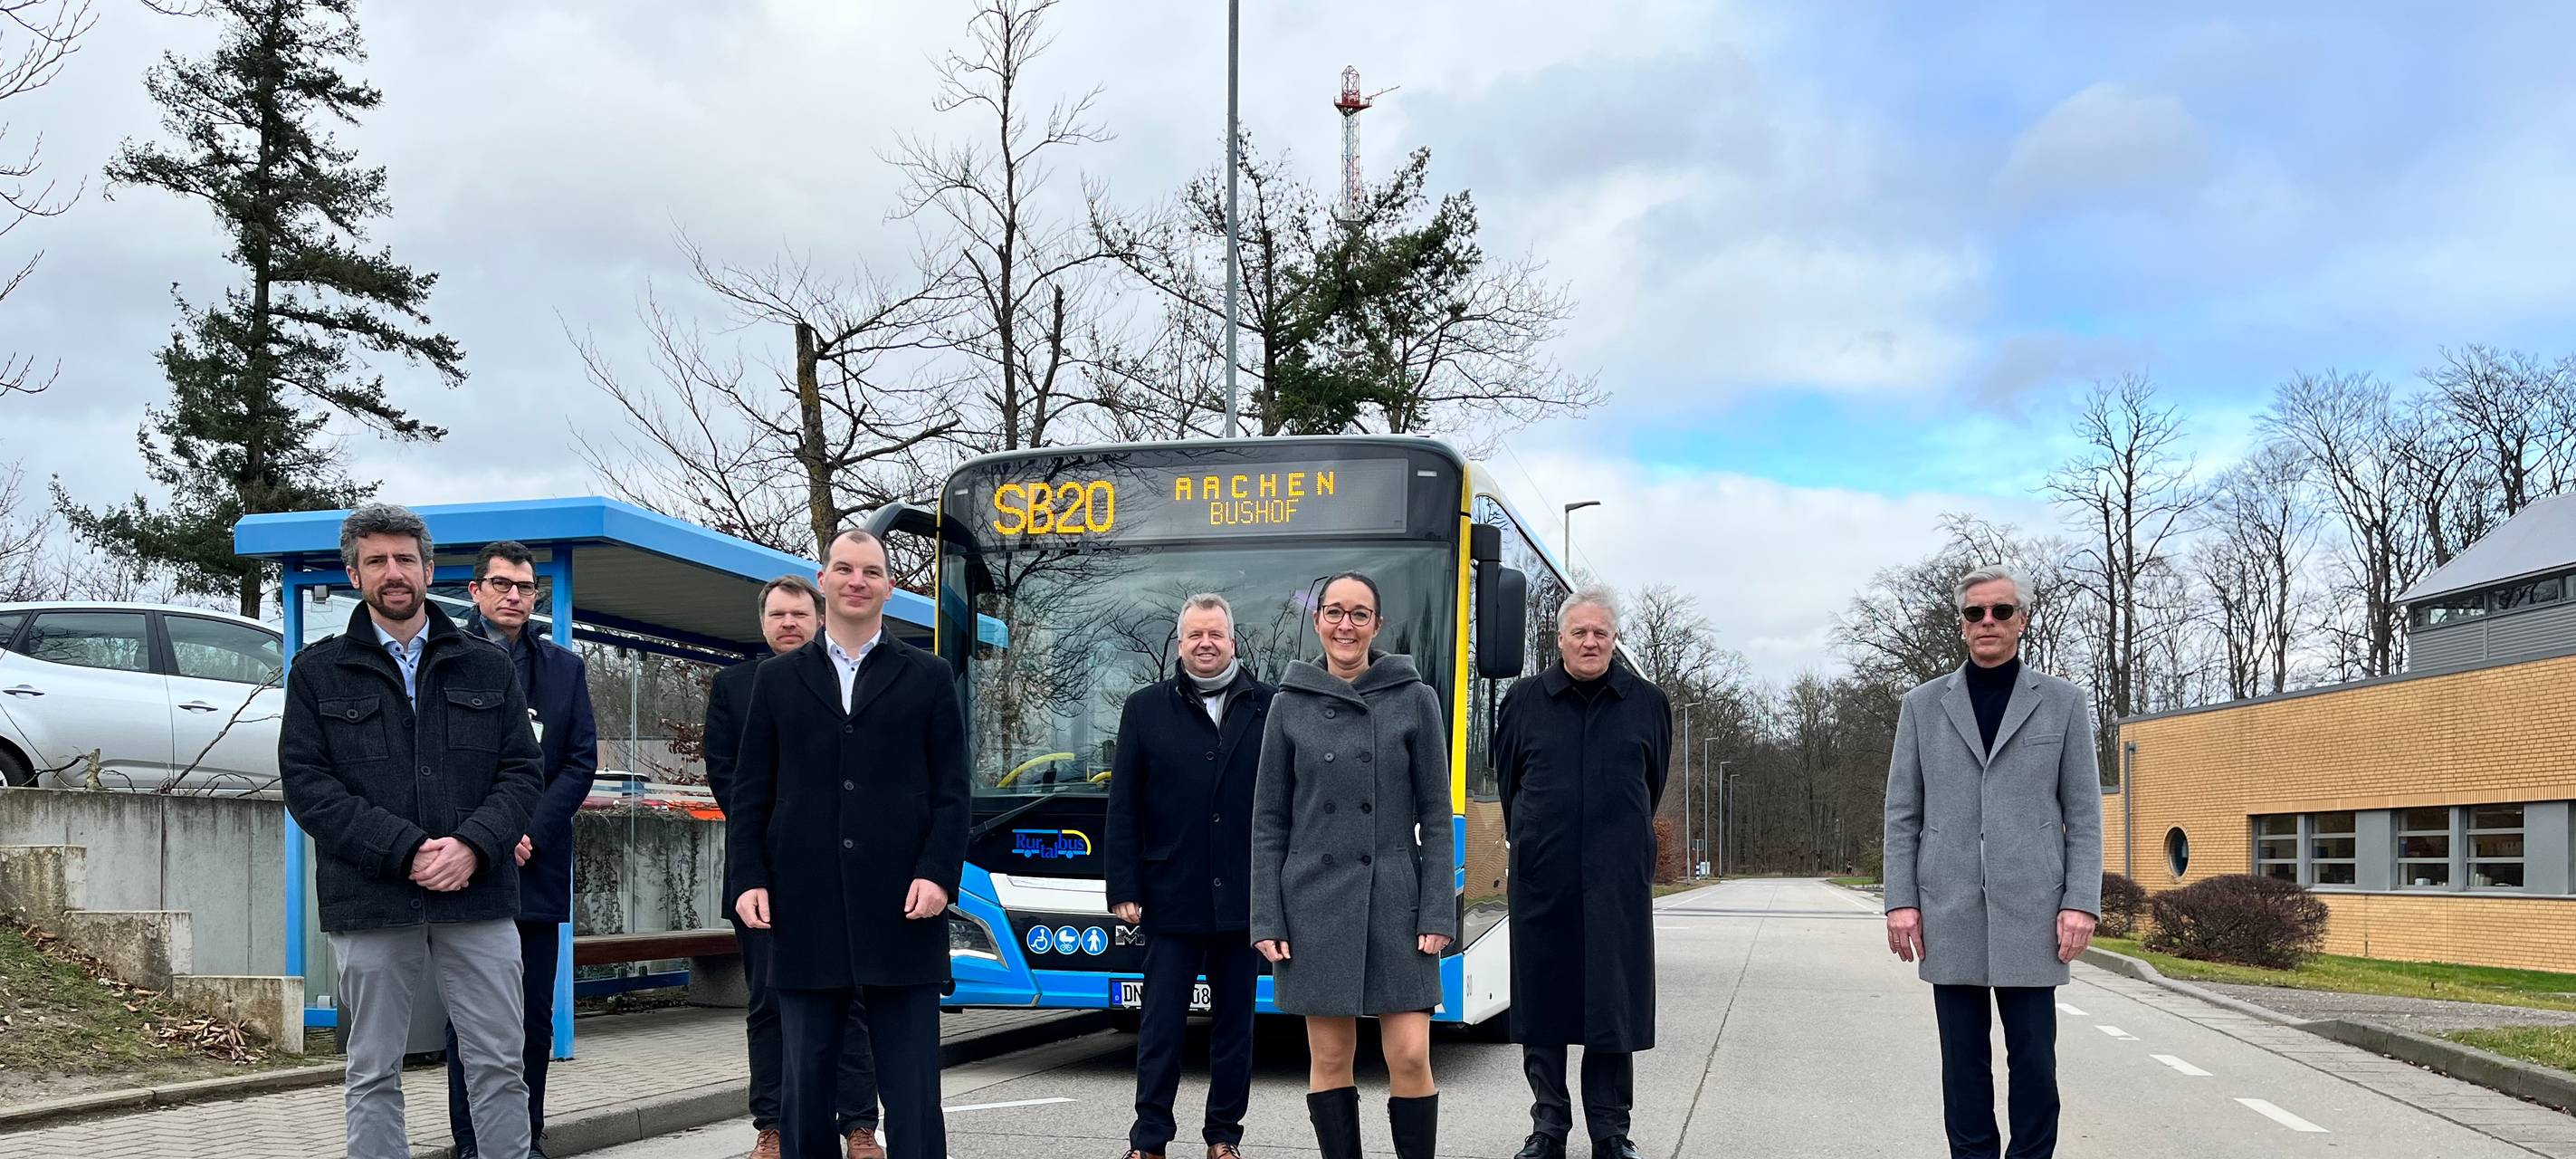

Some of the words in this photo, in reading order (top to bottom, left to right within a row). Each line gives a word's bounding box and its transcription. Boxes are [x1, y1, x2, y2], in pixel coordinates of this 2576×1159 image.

[1175, 471, 1335, 501] AACHEN
[994, 480, 1115, 535] SB20
[1209, 498, 1299, 525] BUSHOF
